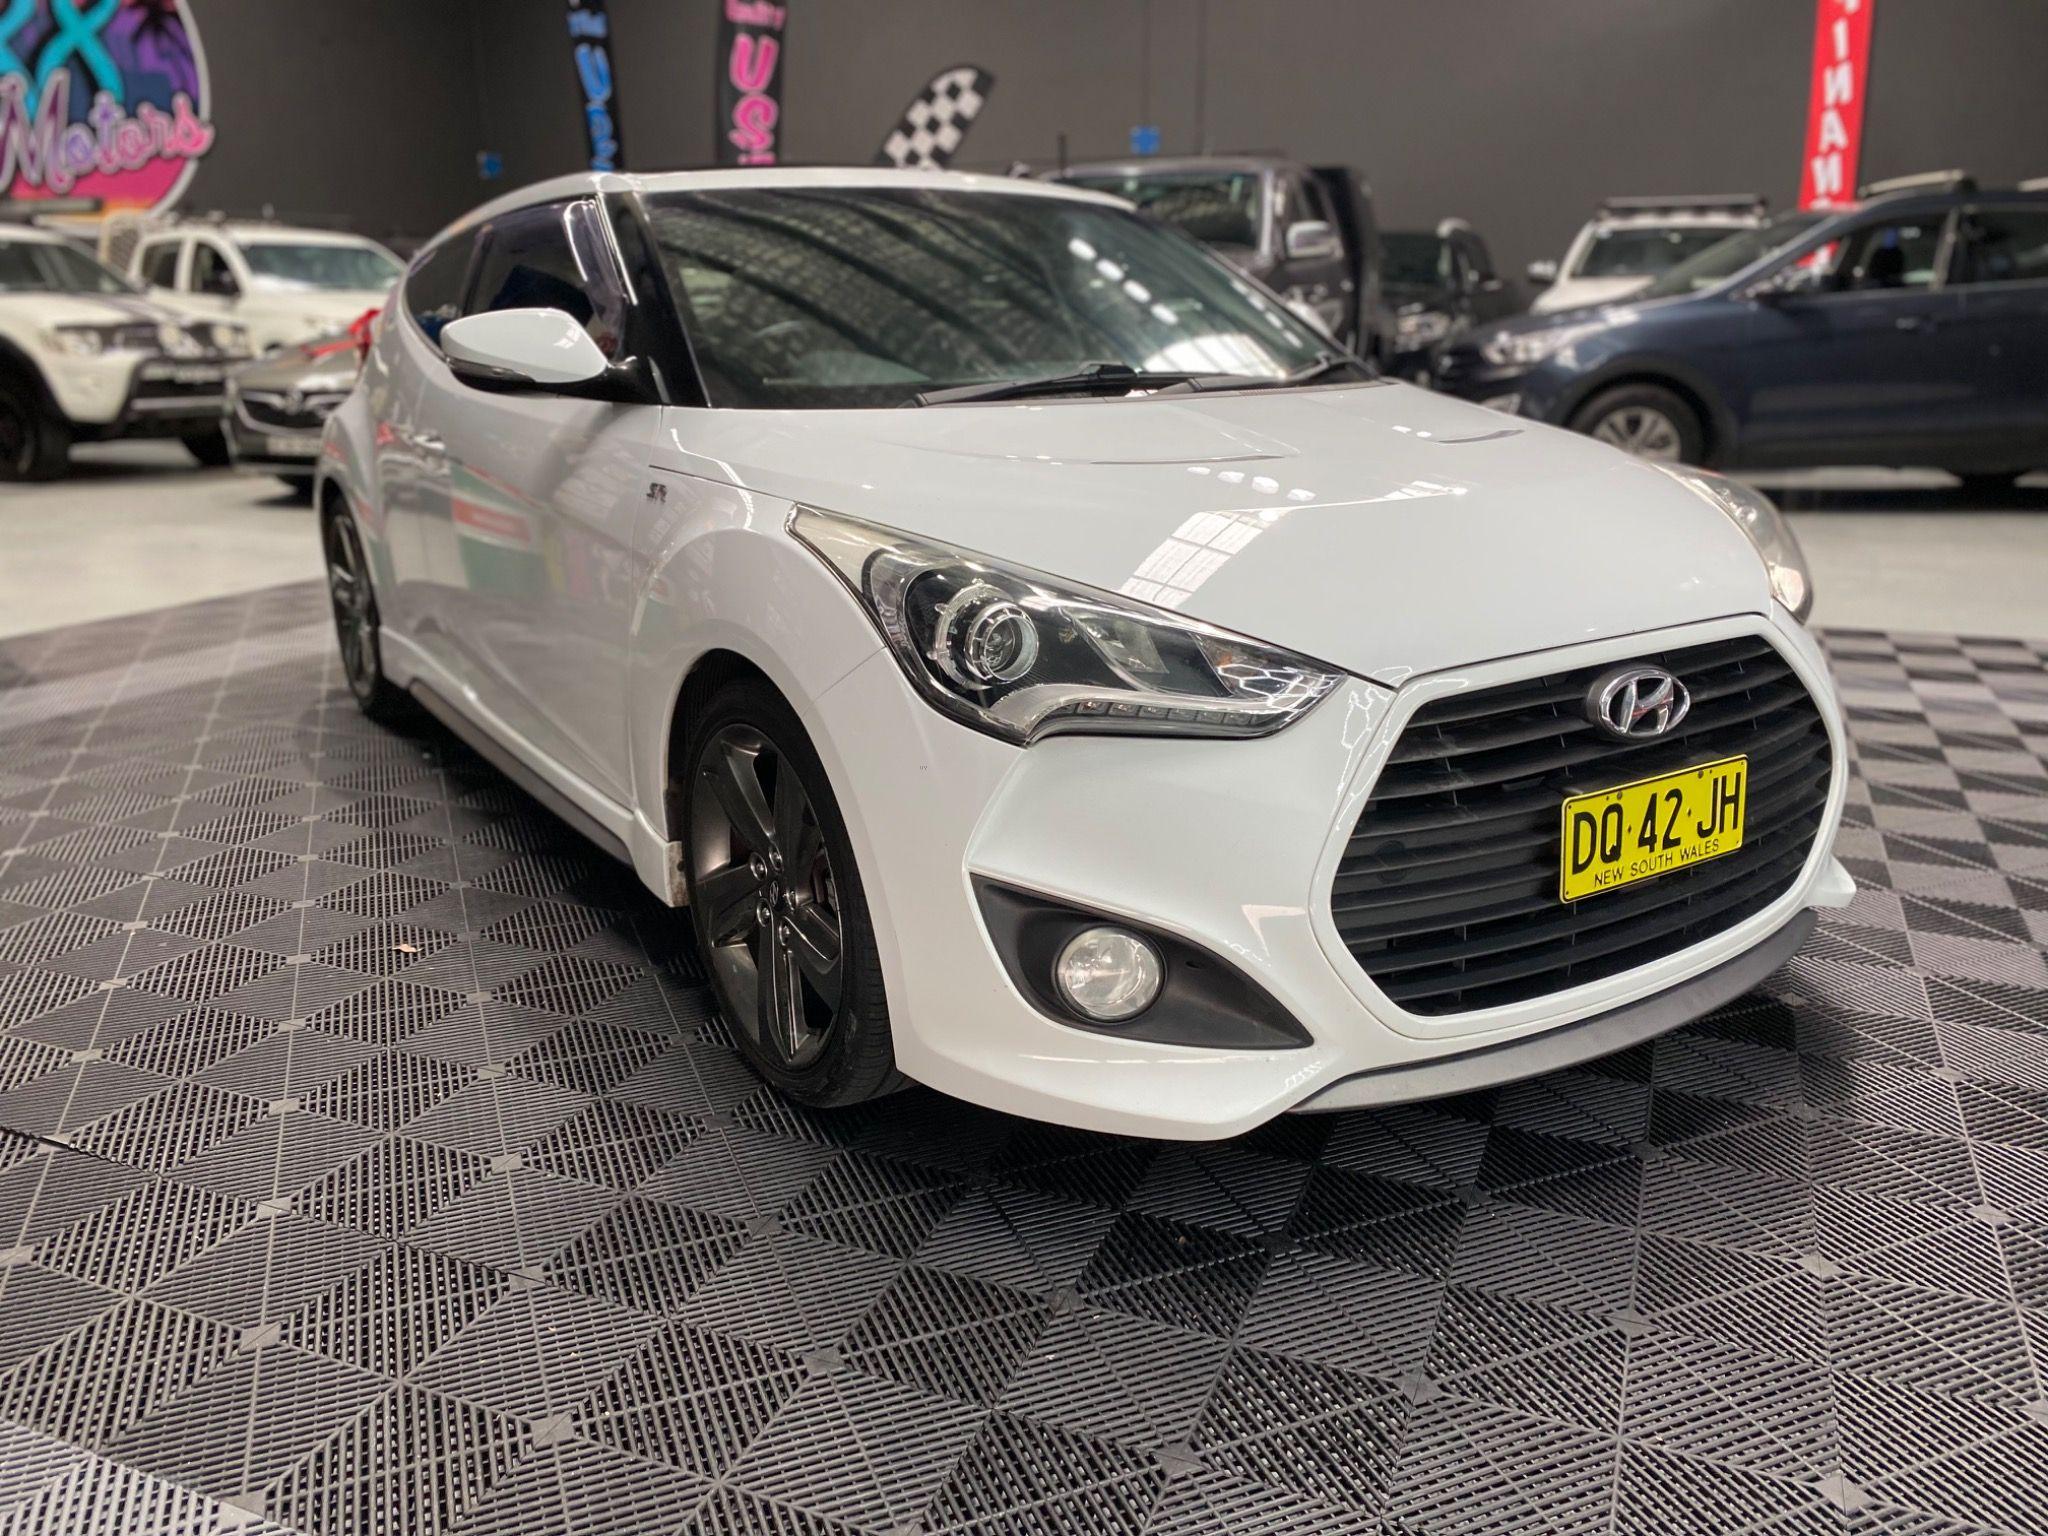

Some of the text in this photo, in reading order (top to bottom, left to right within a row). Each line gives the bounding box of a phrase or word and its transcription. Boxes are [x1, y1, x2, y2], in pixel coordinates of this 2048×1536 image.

[0, 67, 215, 194] Motors
[1594, 838, 1719, 888] NEW SOUTH WALES
